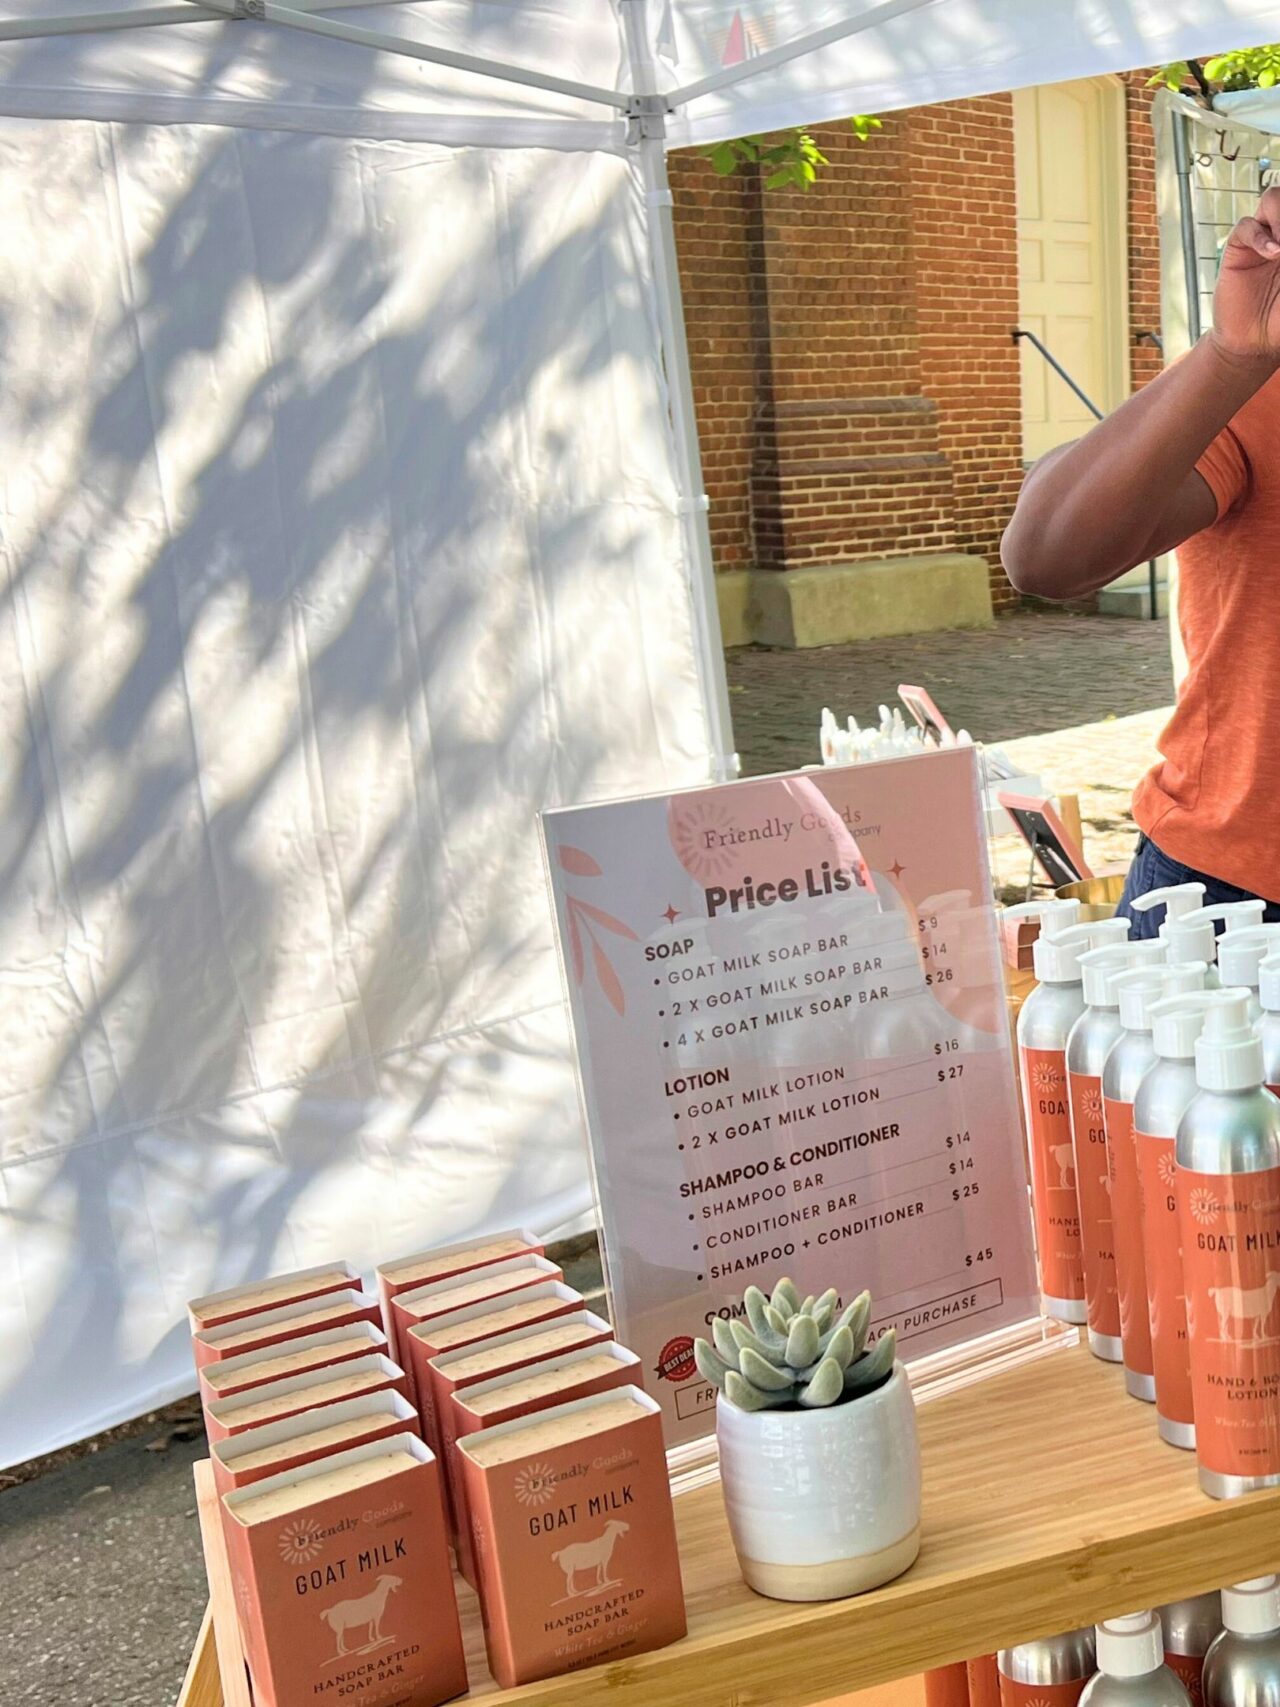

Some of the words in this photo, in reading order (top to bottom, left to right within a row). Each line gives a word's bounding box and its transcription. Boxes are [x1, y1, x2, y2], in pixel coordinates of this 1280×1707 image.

[704, 817, 793, 849] Friendly
[801, 806, 862, 831] Gods
[704, 876, 799, 917] Price
[805, 861, 867, 898] List
[644, 938, 695, 962] SOAP
[668, 962, 716, 985] GOAT
[723, 953, 762, 973] MILK
[768, 942, 811, 964] SOAP
[817, 934, 849, 952] BAR
[672, 1002, 682, 1016] 2
[690, 998, 699, 1012] X
[706, 985, 753, 1008] GOAT
[760, 976, 798, 996] MILK
[804, 964, 846, 986] SOAP
[852, 957, 883, 975] BAR
[677, 1033, 688, 1047] 4
[695, 1029, 705, 1043] X
[711, 1017, 759, 1038] GOAT
[766, 1006, 804, 1026] MILK
[809, 995, 852, 1016] SOAP
[859, 986, 889, 1004] BAR
[664, 1067, 730, 1096] LOTION
[687, 1095, 735, 1118] GOAT
[742, 1084, 779, 1104] MILK
[786, 1067, 846, 1093] LOTION
[692, 1135, 701, 1149] 2
[708, 1131, 718, 1145] X
[725, 1117, 771, 1140] GOAT
[778, 1105, 816, 1126] MILK
[822, 1088, 880, 1114] LOTION
[1040, 1100, 1069, 1115] GOA
[679, 1160, 769, 1197] SHAMPOO
[773, 1157, 787, 1171] &
[790, 1123, 900, 1166] CONDITIONER
[702, 1184, 786, 1219] SHAMPOO
[793, 1173, 824, 1192] BAR
[706, 1204, 821, 1249] CONDITIONER
[827, 1193, 857, 1212] BAR
[710, 1243, 796, 1279] SHAMPOO
[802, 1239, 812, 1249] +
[817, 1202, 925, 1245] CONDITIONER
[1198, 1232, 1235, 1252] GOAT
[904, 1294, 977, 1330] PURCHASE
[663, 1356, 680, 1373] BEST
[1208, 1373, 1245, 1388] HAND
[1227, 1387, 1278, 1400] LOTION
[529, 1504, 577, 1536] GOAT
[589, 1485, 634, 1517] MILK
[296, 1560, 346, 1595] GOAT
[358, 1537, 407, 1572] MILK
[544, 1588, 645, 1632] HANDCRAFTED
[567, 1618, 600, 1636] SOAP
[604, 1608, 629, 1623] BAR
[313, 1644, 420, 1694] HANDCRAFTED
[338, 1677, 373, 1697] SOAP
[378, 1665, 404, 1681] BAR
